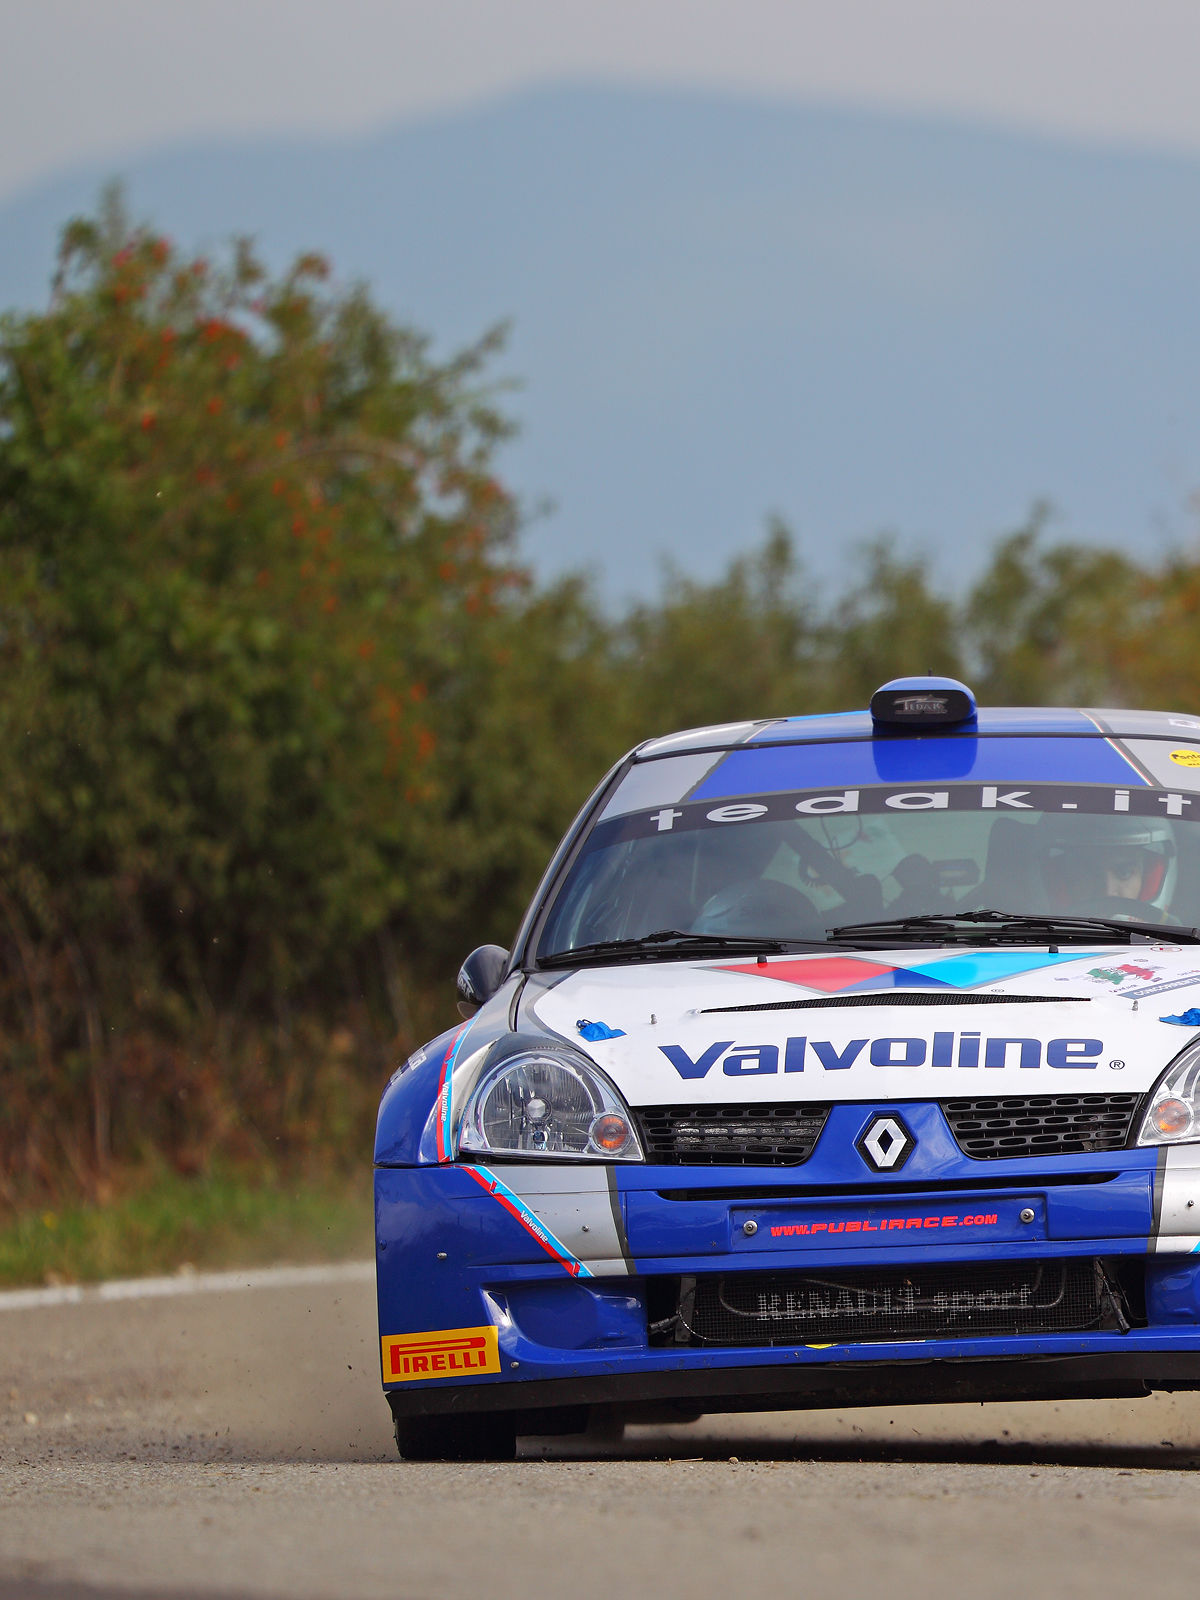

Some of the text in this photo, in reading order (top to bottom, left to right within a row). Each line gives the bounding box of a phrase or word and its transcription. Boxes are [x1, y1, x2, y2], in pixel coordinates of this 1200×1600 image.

[649, 786, 1192, 831] tedak.it
[657, 1031, 1104, 1080] Valvoline
[441, 1081, 449, 1122] Valvoline
[520, 1210, 548, 1243] Valvoline
[757, 1287, 921, 1321] RENAULT
[390, 1336, 486, 1374] PIRELLI
